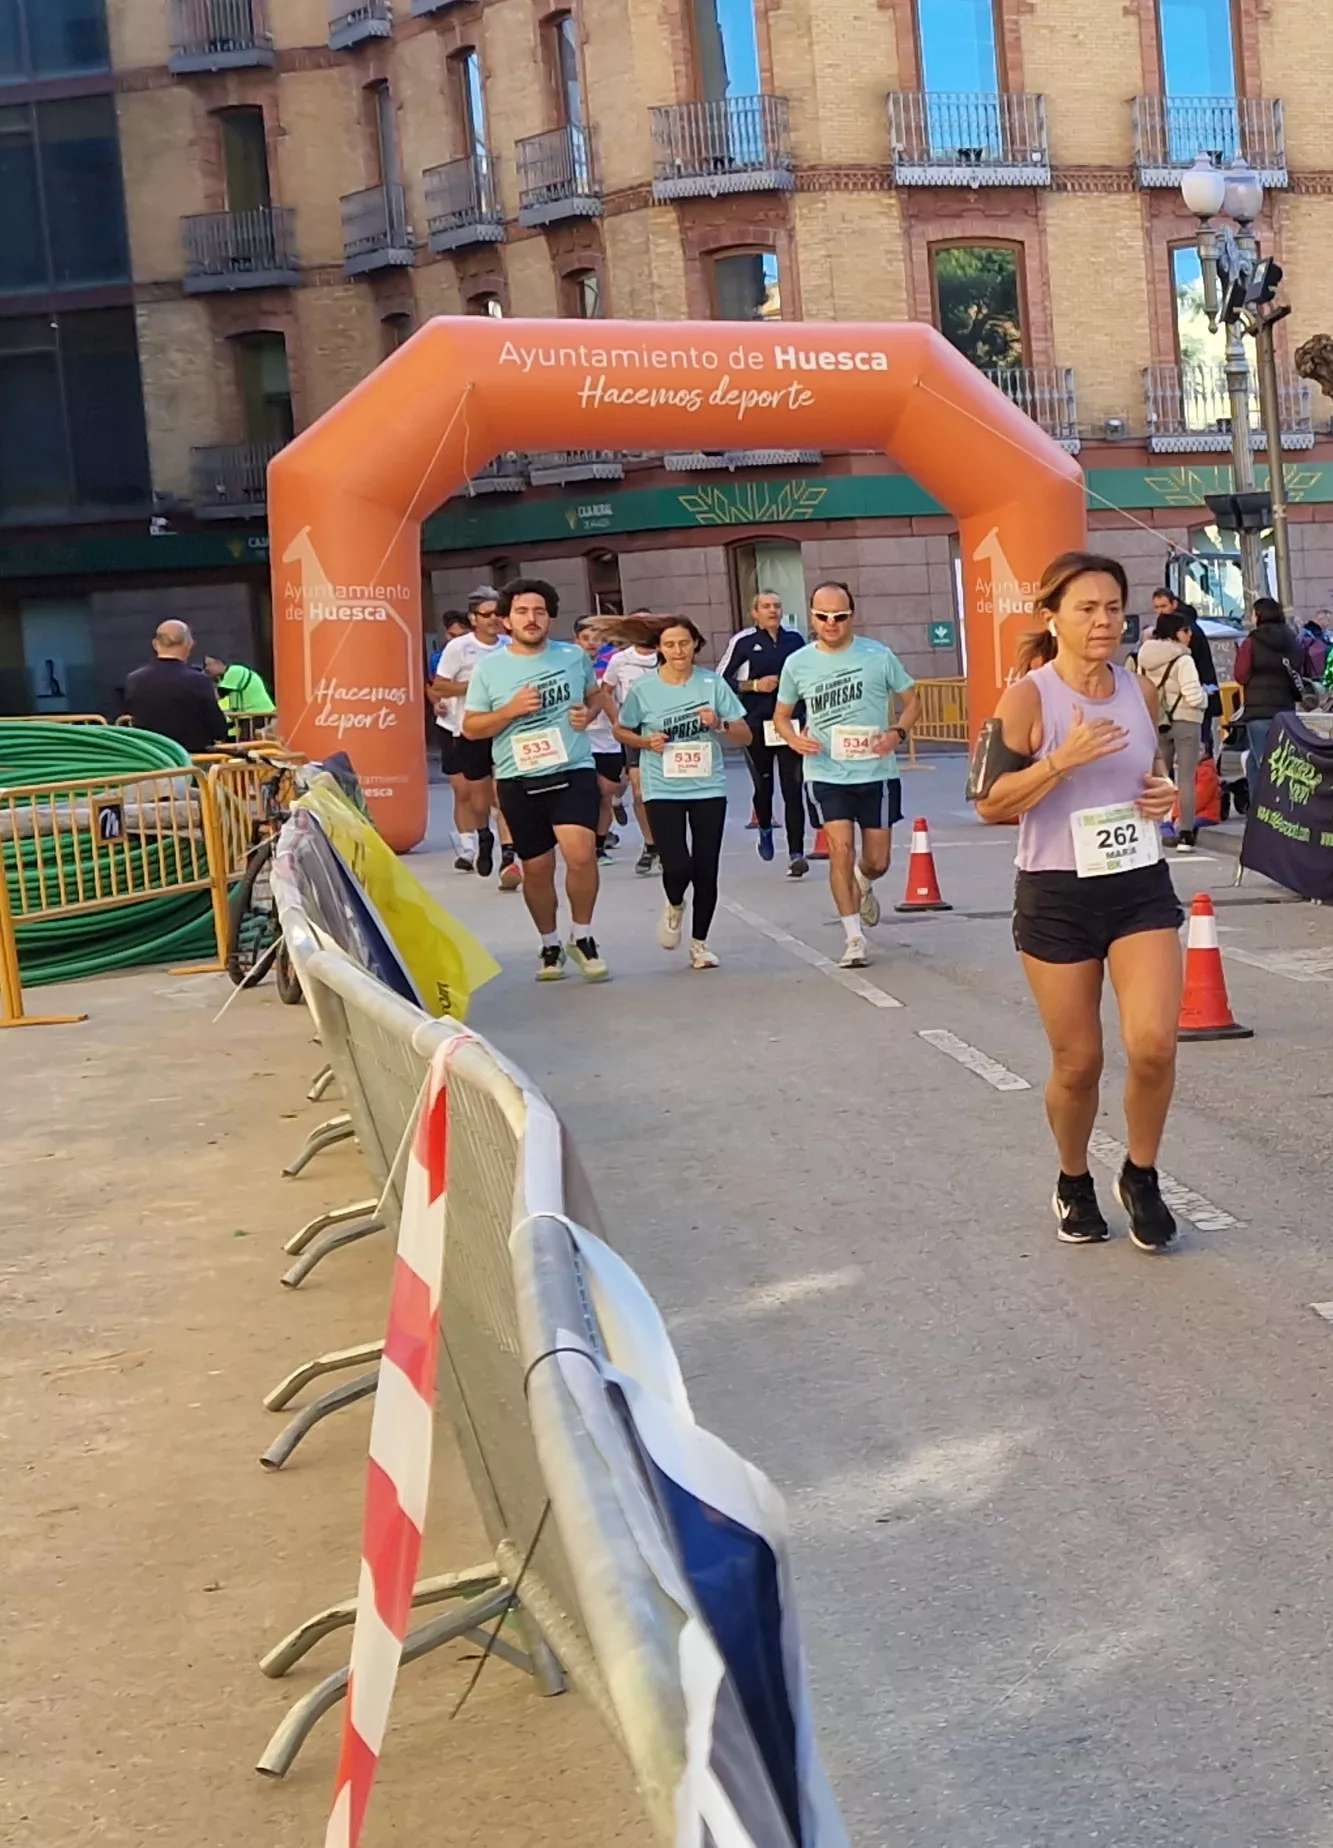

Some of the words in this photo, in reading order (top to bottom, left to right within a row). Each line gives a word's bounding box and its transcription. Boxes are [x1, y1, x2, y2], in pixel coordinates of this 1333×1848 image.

[499, 340, 719, 373] Ayuntamiento
[729, 345, 764, 370] de
[774, 345, 889, 371] Huesca
[577, 374, 703, 412] Hacemos
[709, 374, 815, 421] deporte
[284, 581, 410, 603] Ayuntamiento
[285, 604, 303, 621] de
[309, 604, 388, 621] Huesca
[976, 598, 994, 614] de
[1000, 599, 1034, 614] Hue
[315, 677, 407, 705] Hacemos
[810, 681, 863, 715] EMPRESAS
[315, 703, 398, 739] deporte
[522, 740, 551, 755] 533
[843, 737, 869, 748] 534
[675, 752, 701, 763] 535
[1096, 823, 1139, 850] 262
